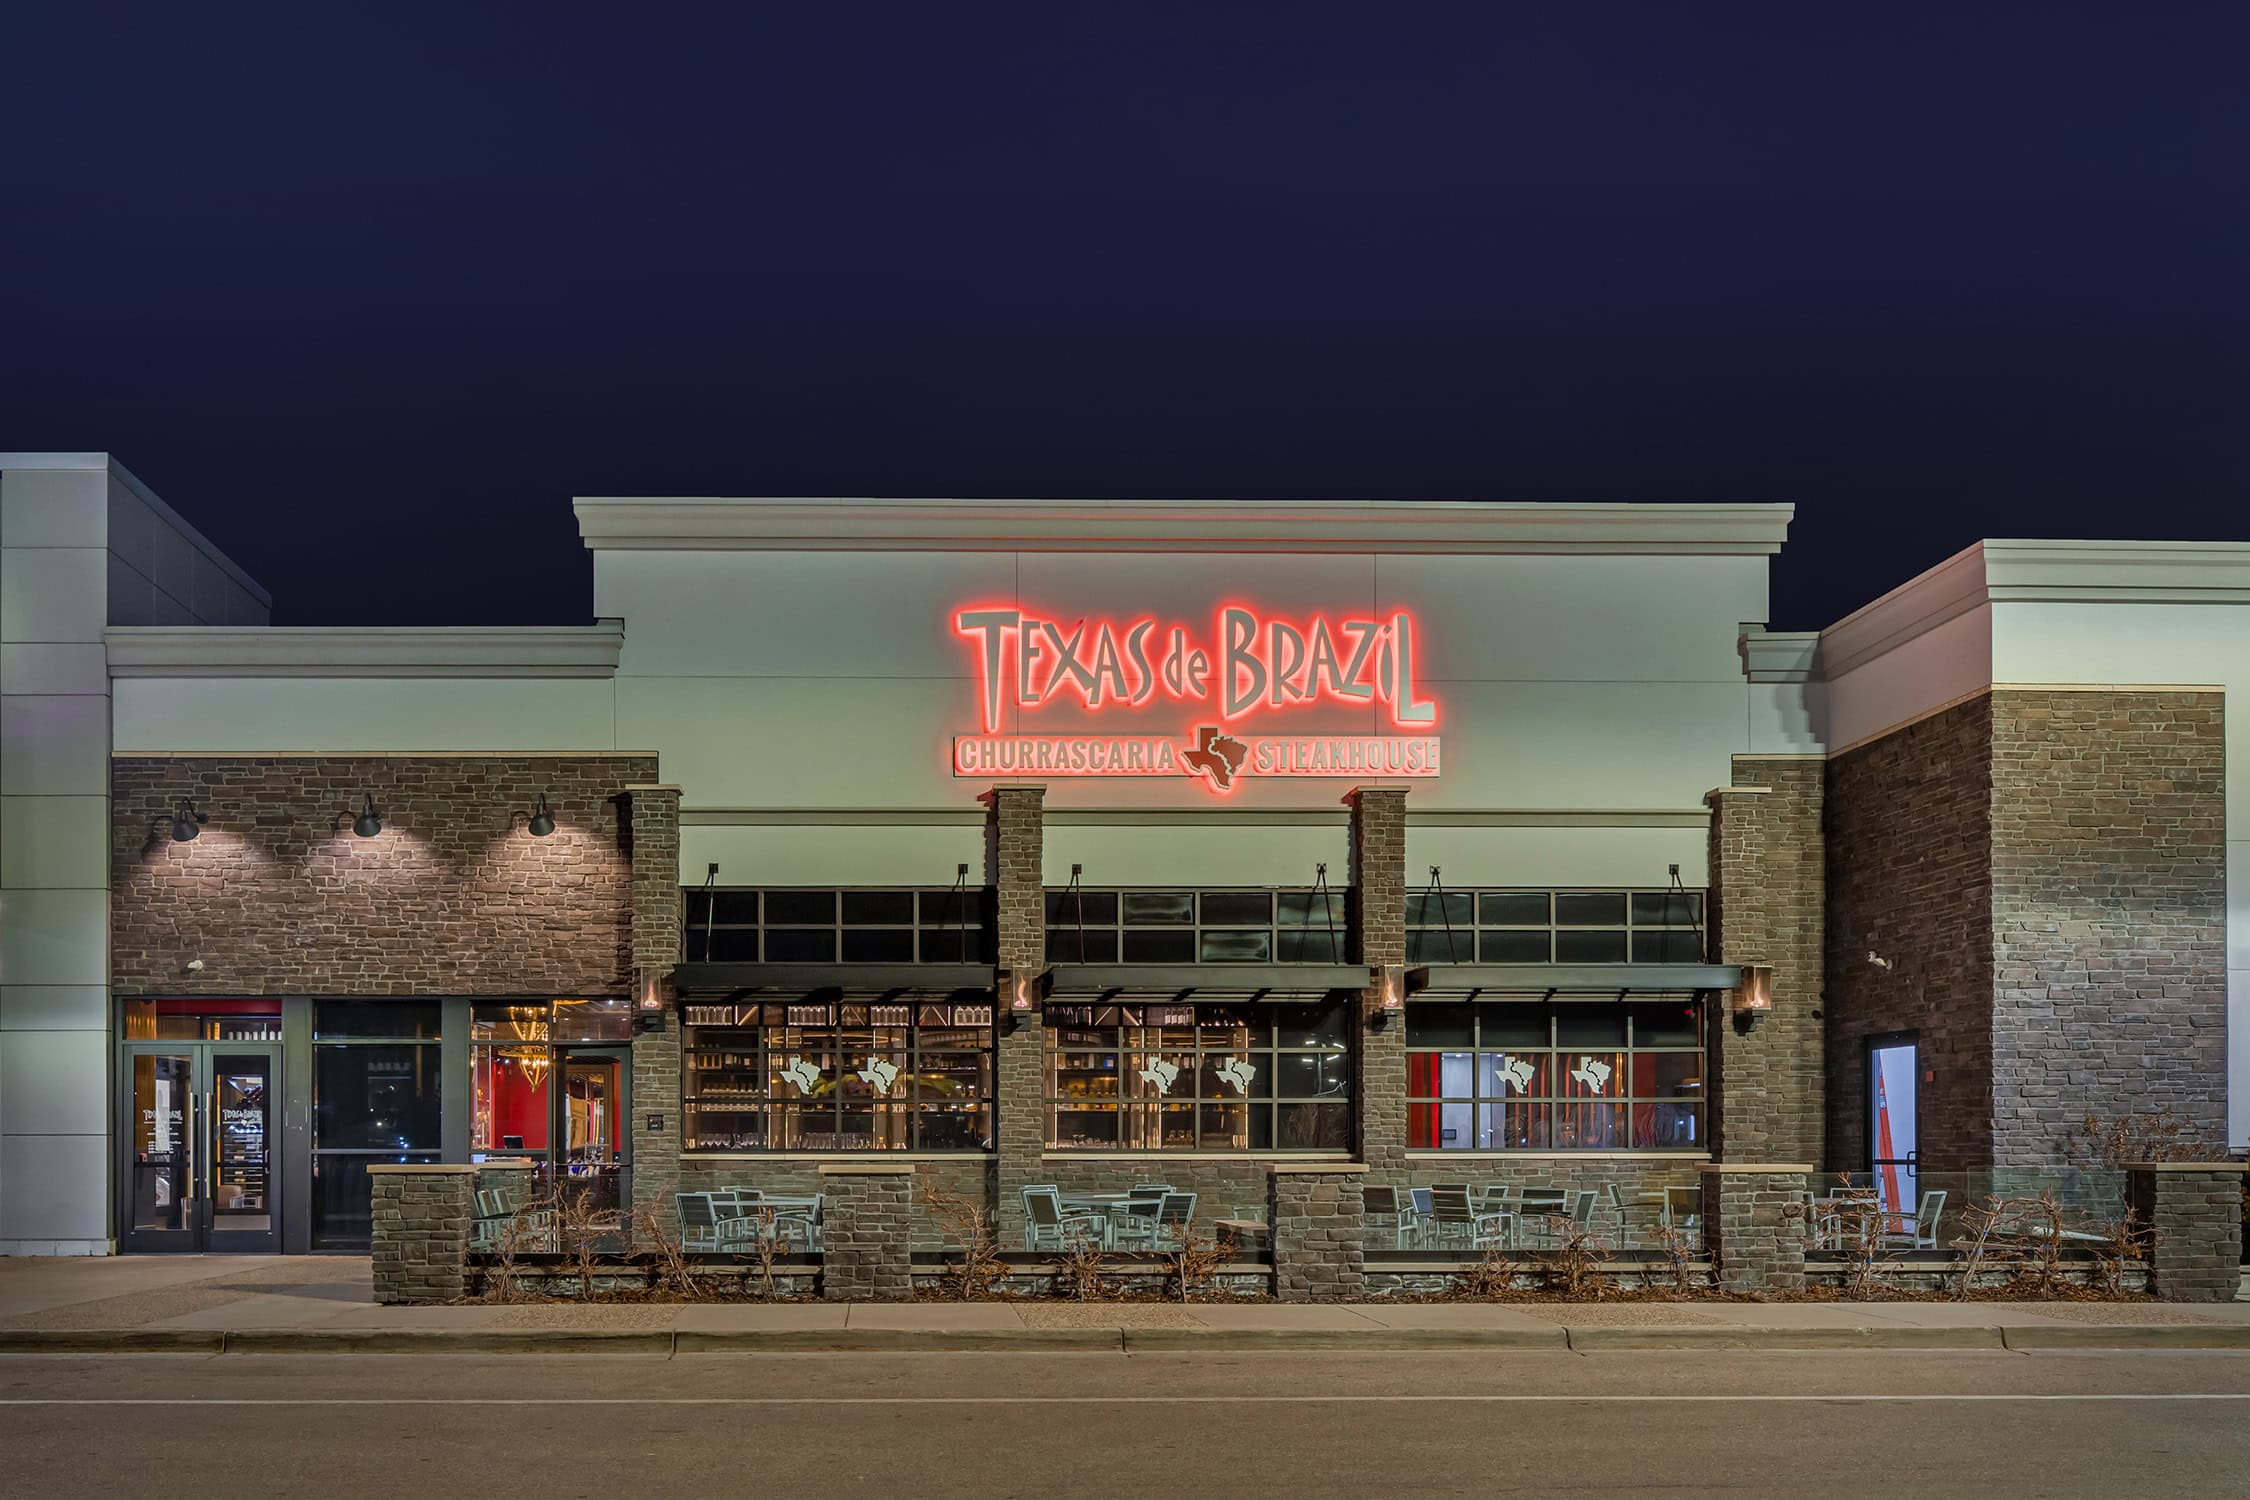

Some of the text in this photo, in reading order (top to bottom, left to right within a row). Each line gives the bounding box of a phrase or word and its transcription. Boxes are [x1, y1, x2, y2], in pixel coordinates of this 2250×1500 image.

[959, 611, 1154, 731] TEXAS
[1165, 628, 1208, 698] de
[960, 740, 1438, 770] CHURRASCARIA STEAKHOUSE
